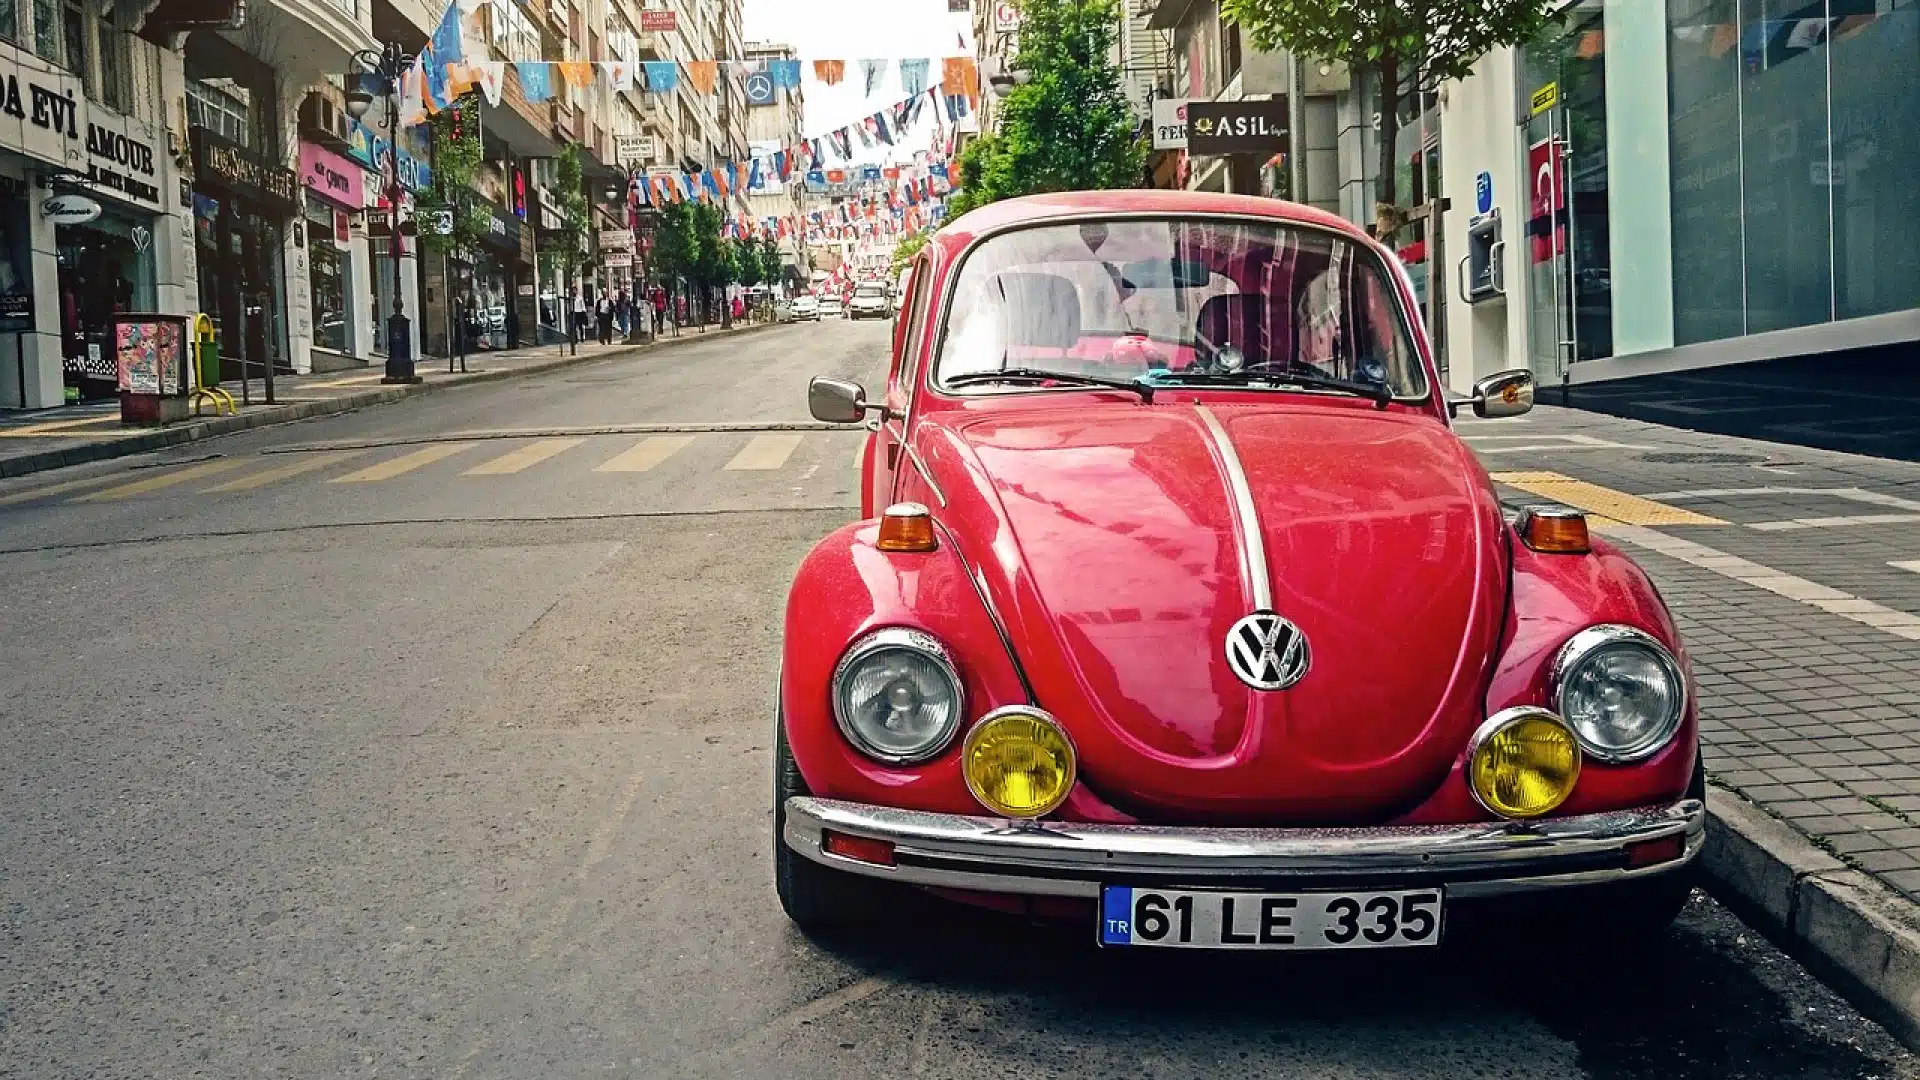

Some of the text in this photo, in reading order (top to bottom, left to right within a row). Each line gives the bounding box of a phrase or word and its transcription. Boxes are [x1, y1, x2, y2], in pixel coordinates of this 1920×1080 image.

[0, 73, 79, 139] A EVİ
[86, 122, 154, 177] AMOUR
[1106, 893, 1439, 945] TR 61 LE 335
